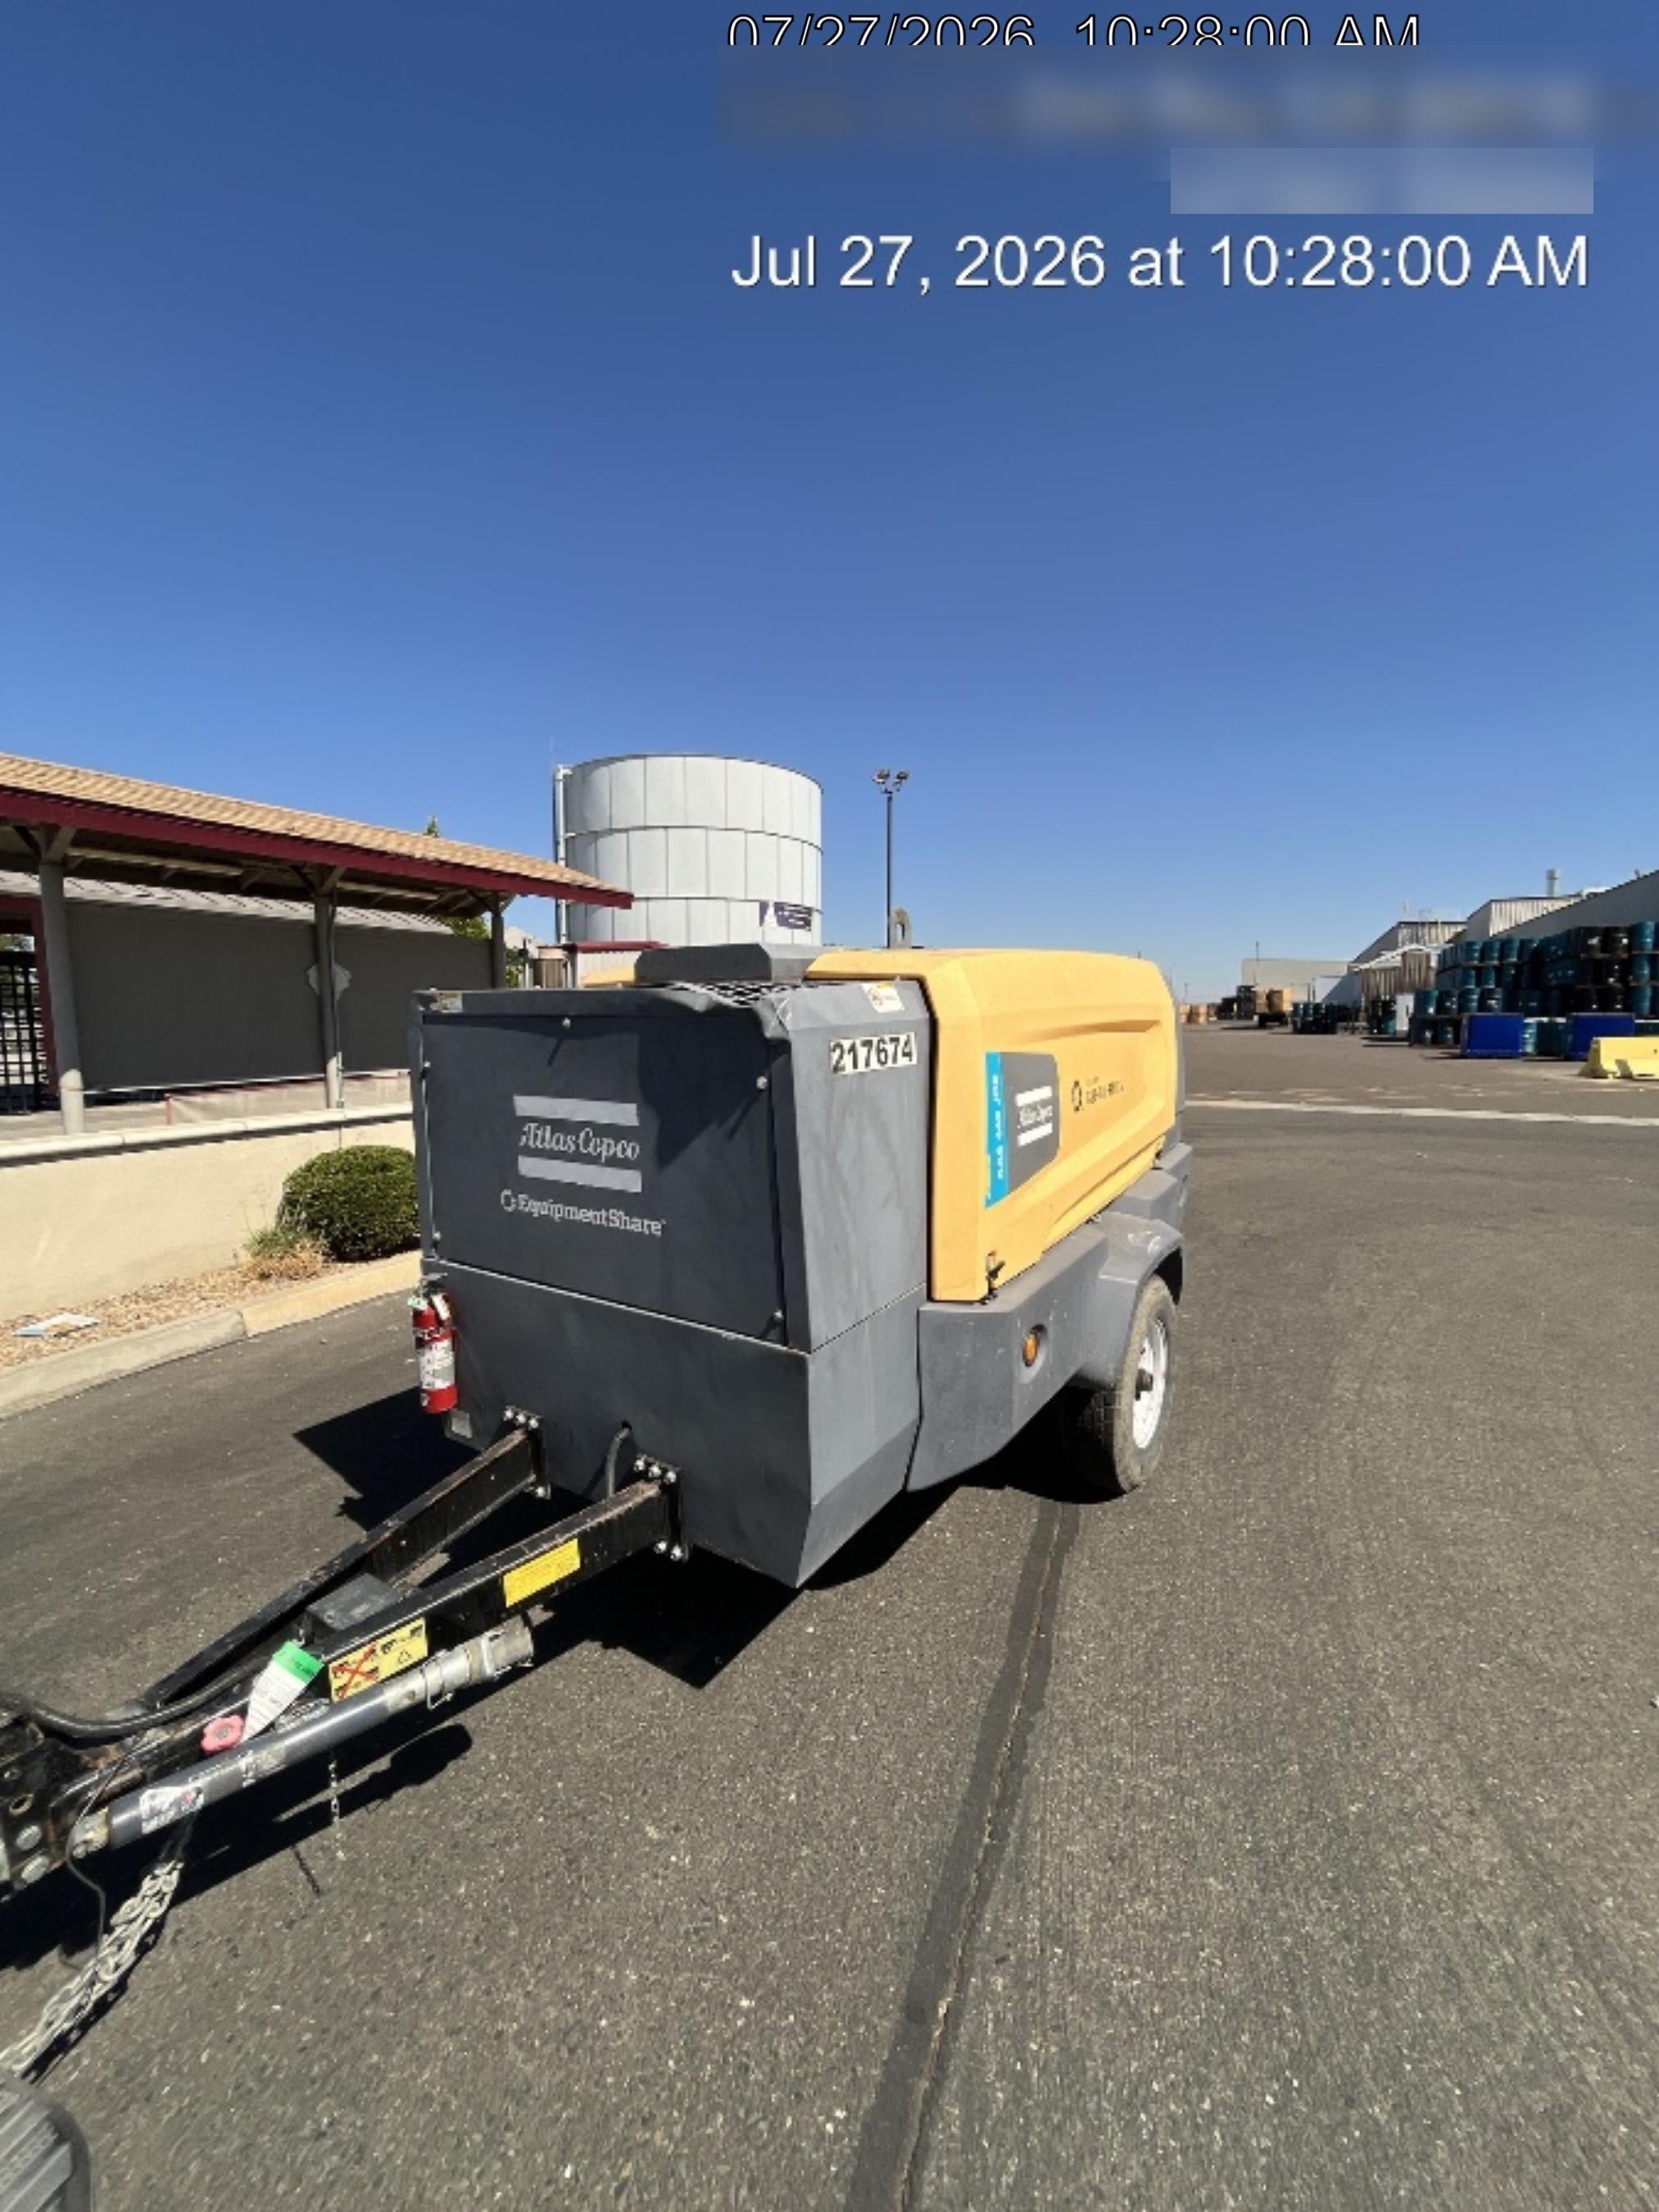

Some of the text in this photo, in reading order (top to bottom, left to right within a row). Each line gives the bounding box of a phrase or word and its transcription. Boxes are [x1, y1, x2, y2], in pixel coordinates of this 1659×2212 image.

[832, 1034, 913, 1074] 217674
[519, 1122, 640, 1163] Atlas Copco
[518, 1193, 665, 1236] EquipmentShare
